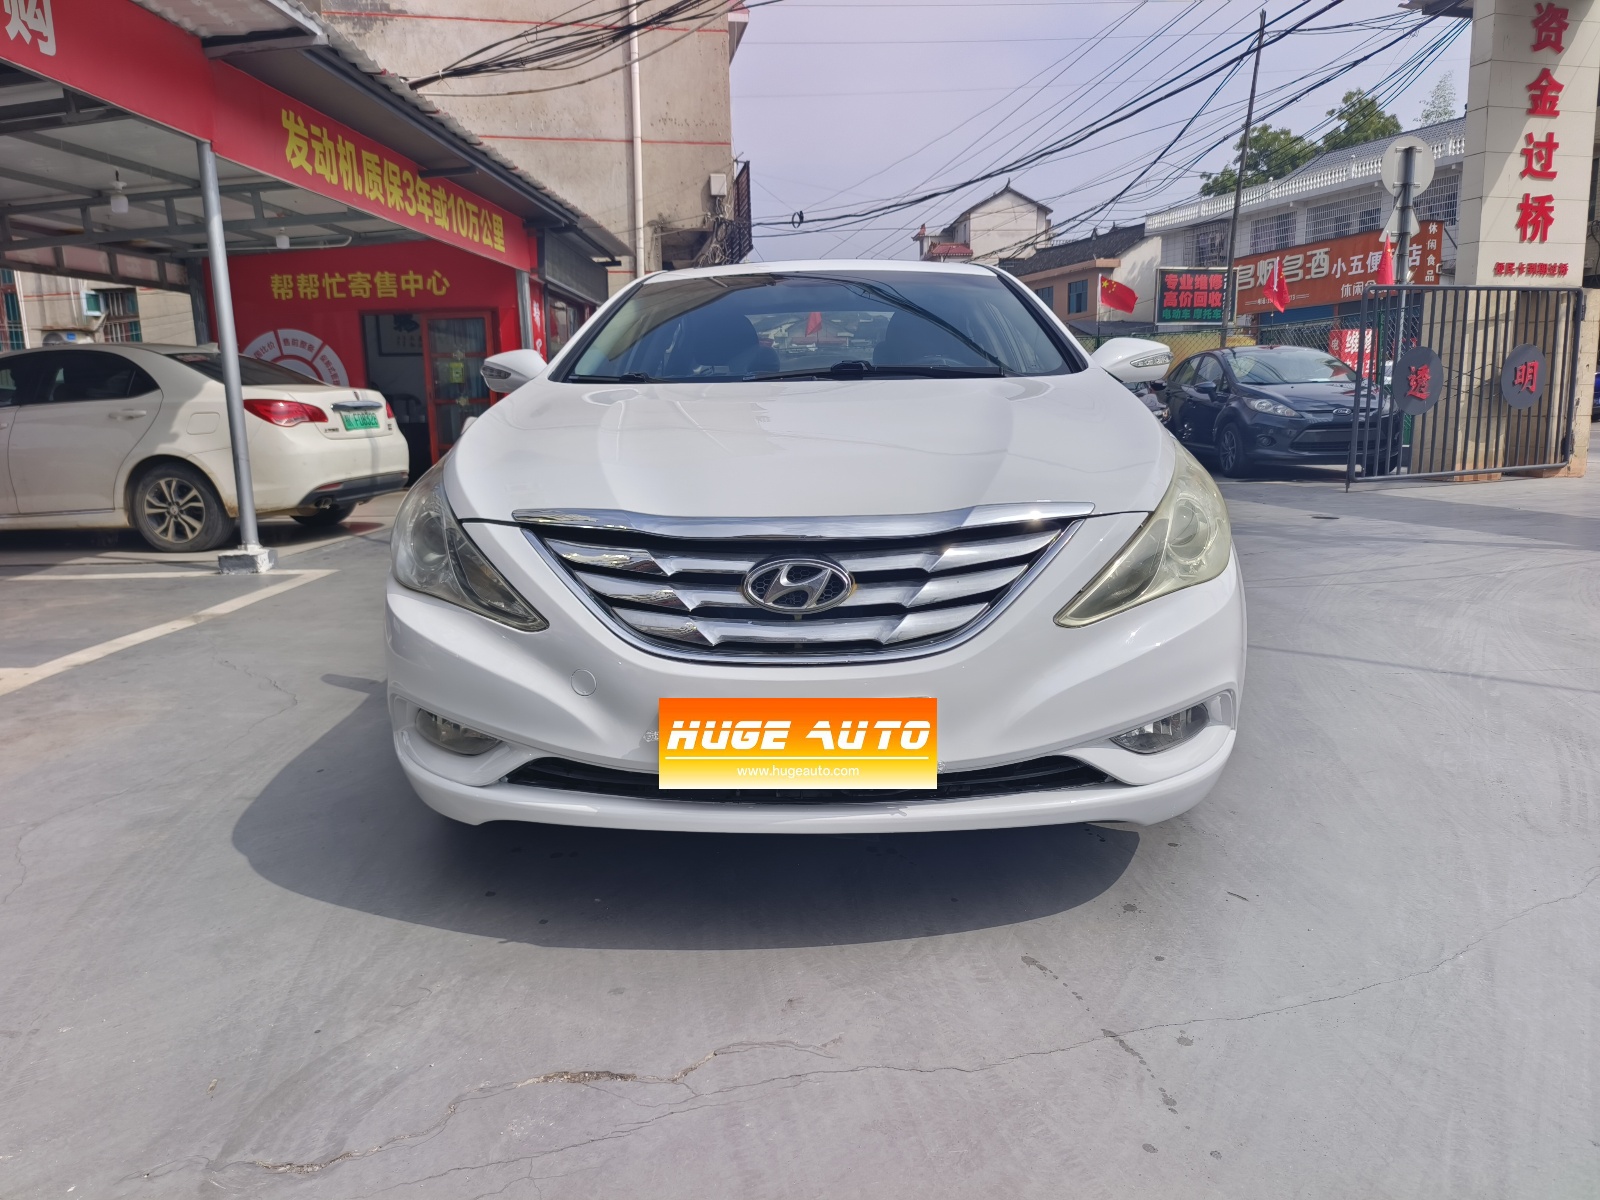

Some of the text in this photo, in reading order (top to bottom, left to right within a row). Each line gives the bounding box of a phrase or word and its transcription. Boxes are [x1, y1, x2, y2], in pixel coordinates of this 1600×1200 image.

[1517, 3, 1570, 243] 资金过桥
[281, 109, 506, 253] 发动机质保3年或10万公里
[1425, 222, 1438, 282] 休闲食品
[270, 270, 450, 301] 帮帮忙寄售中心
[1163, 291, 1222, 308] 高价回收
[1164, 273, 1223, 290] 专业维修
[1406, 364, 1431, 400] 透
[1513, 359, 1540, 394] 明
